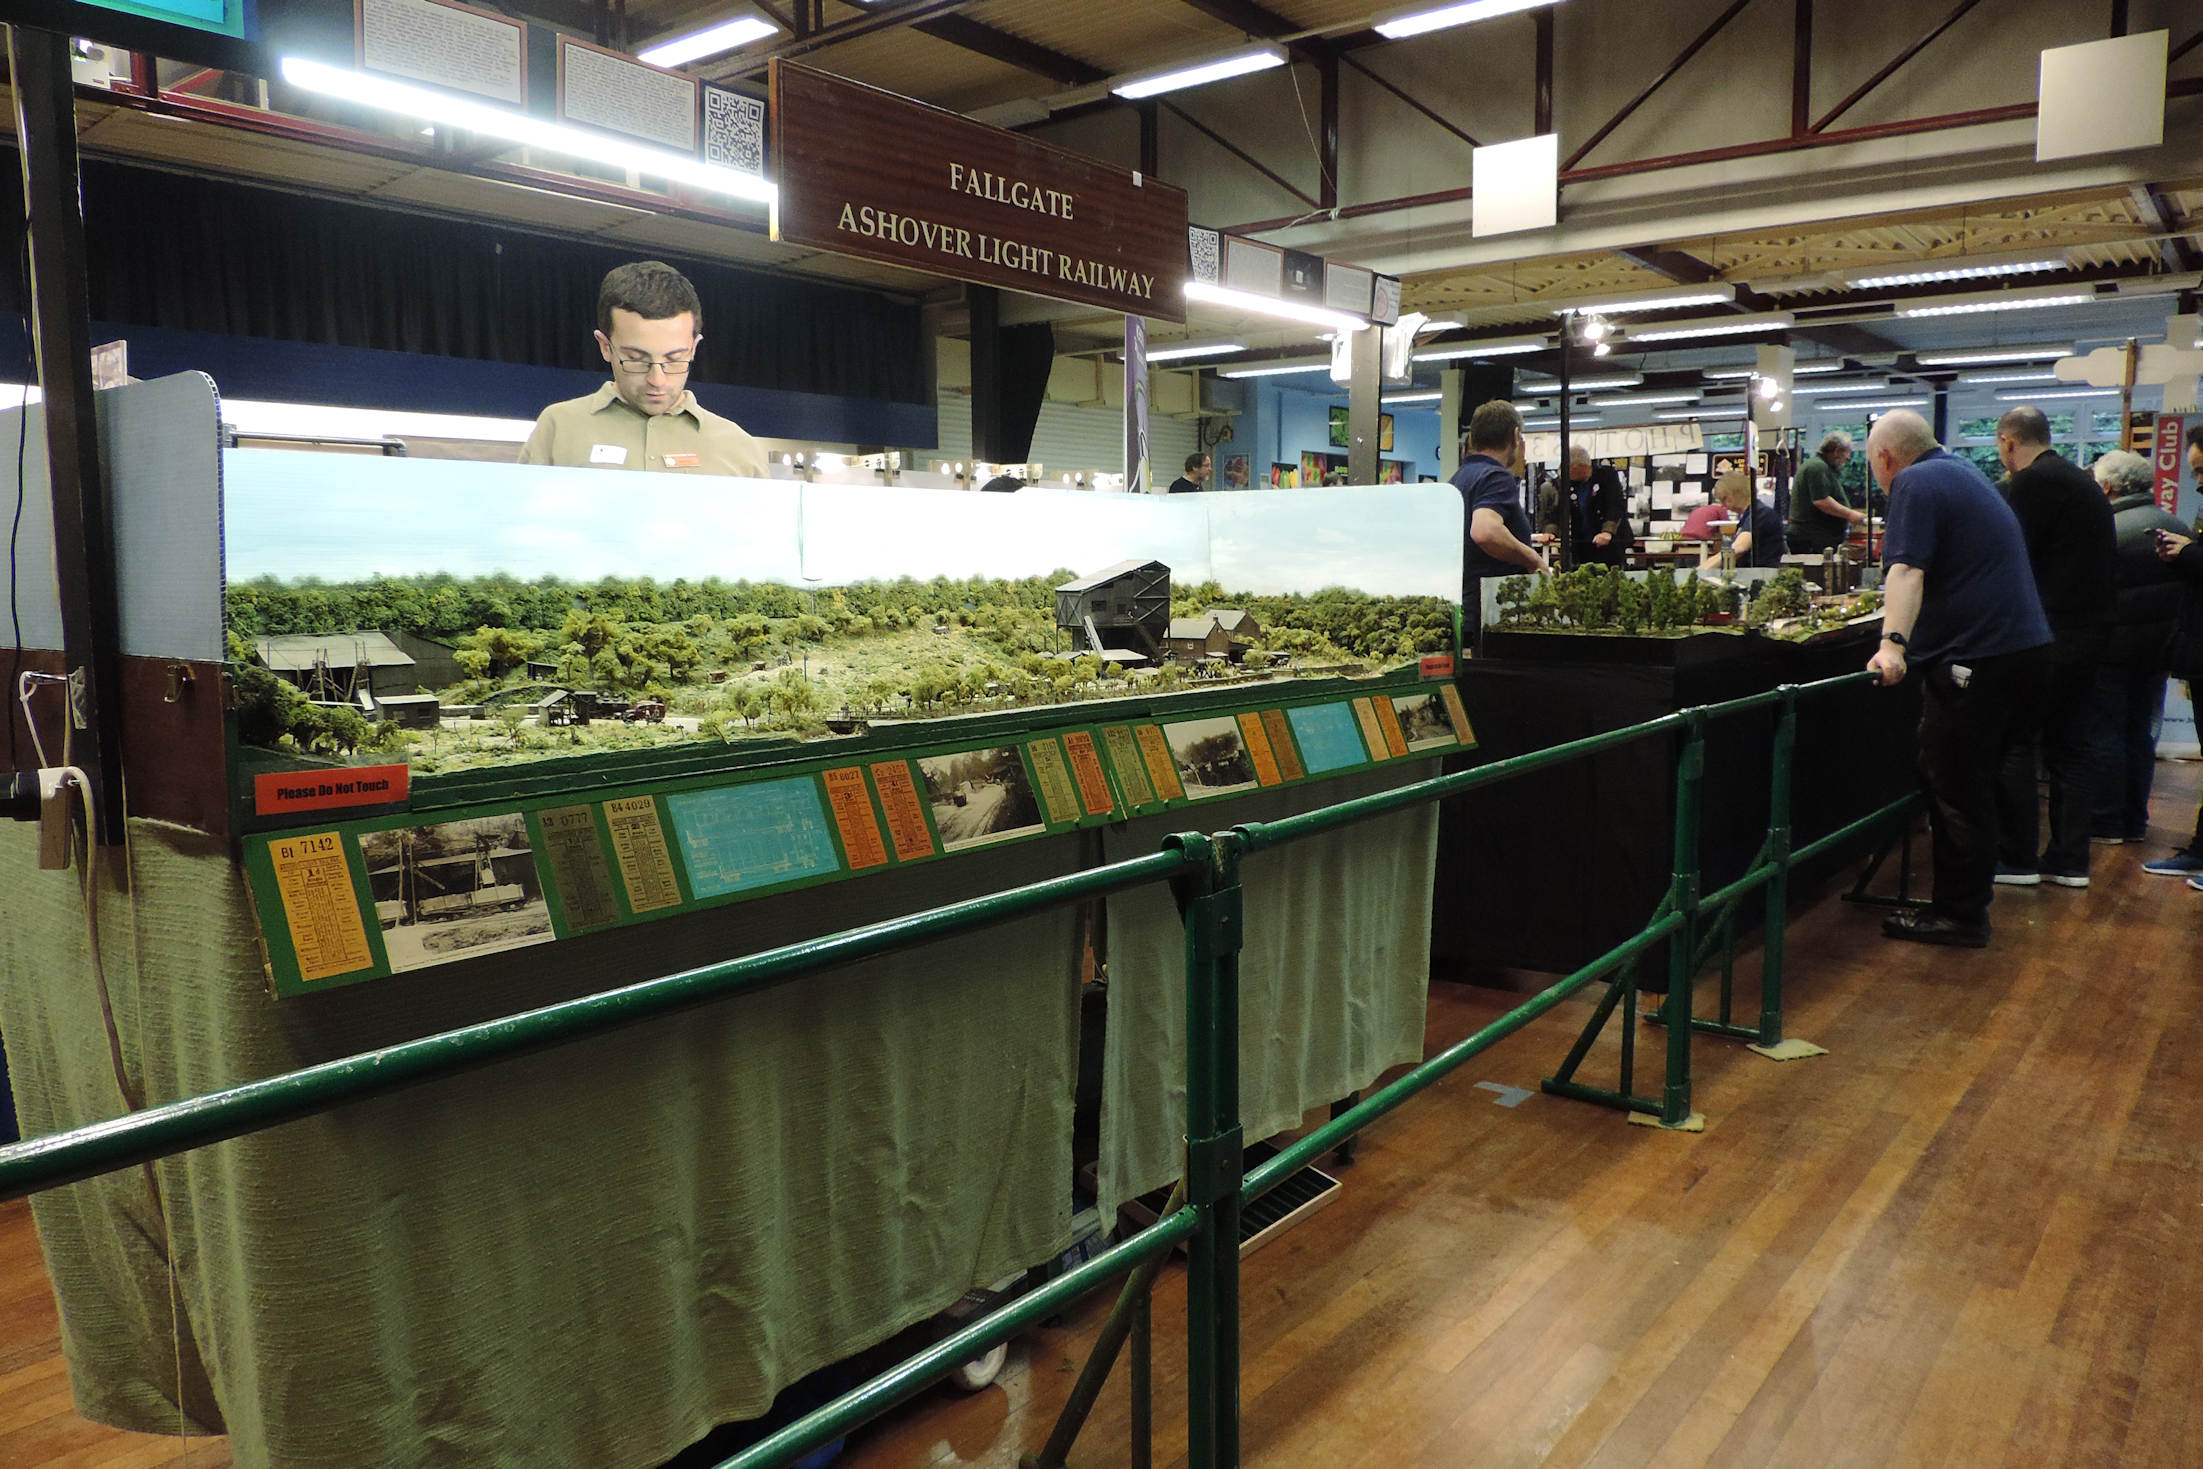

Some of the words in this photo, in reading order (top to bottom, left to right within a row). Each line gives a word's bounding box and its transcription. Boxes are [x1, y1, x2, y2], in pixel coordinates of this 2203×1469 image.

[949, 162, 1074, 221] FALLGATE
[837, 202, 973, 259] ASHOVER
[977, 233, 1054, 276] LIGHT
[1058, 254, 1155, 300] RAILWAY
[2159, 421, 2179, 471] Club
[277, 787, 316, 801] Please
[318, 784, 333, 797] Do
[335, 782, 354, 795] Not
[356, 779, 389, 793] Touch
[300, 837, 334, 854] 7142
